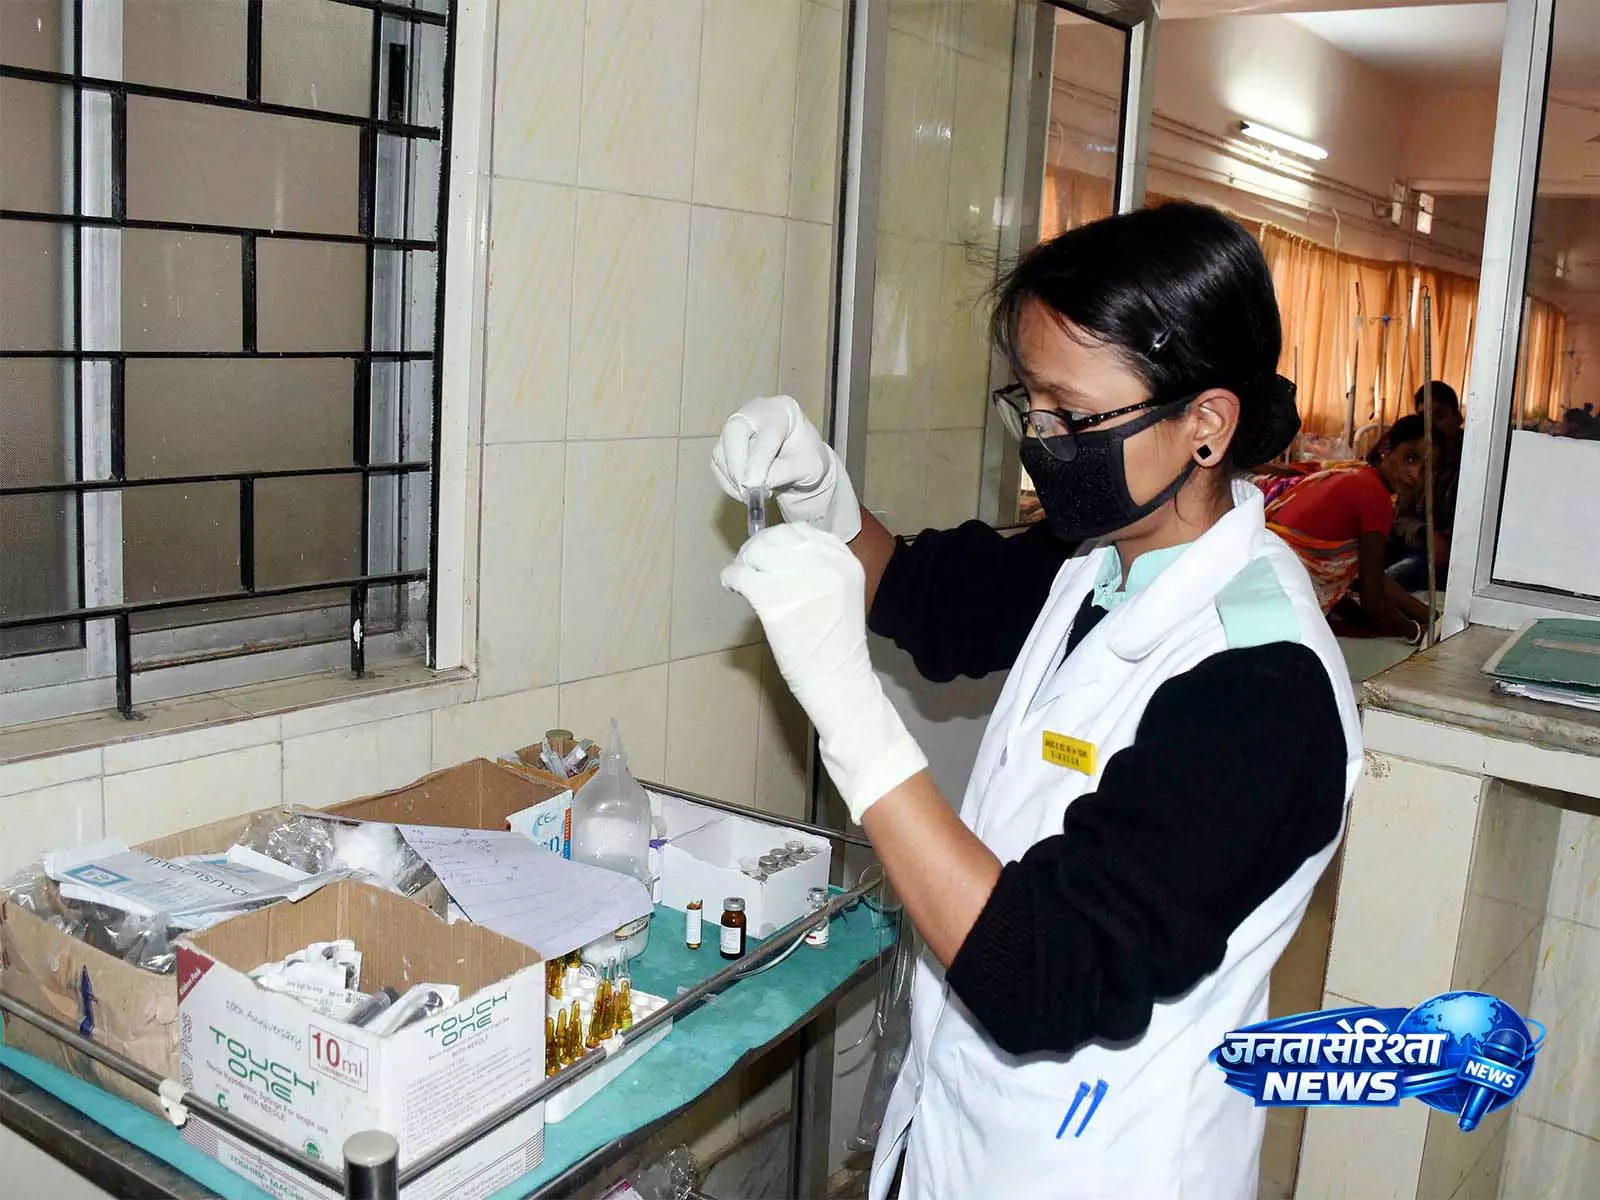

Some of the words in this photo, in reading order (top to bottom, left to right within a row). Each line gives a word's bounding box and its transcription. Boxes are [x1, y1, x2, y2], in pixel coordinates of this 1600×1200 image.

[424, 991, 508, 1038] TOUCH
[441, 1012, 492, 1047] ONE
[208, 1025, 316, 1097] TOUCH
[228, 1057, 293, 1105] ONE
